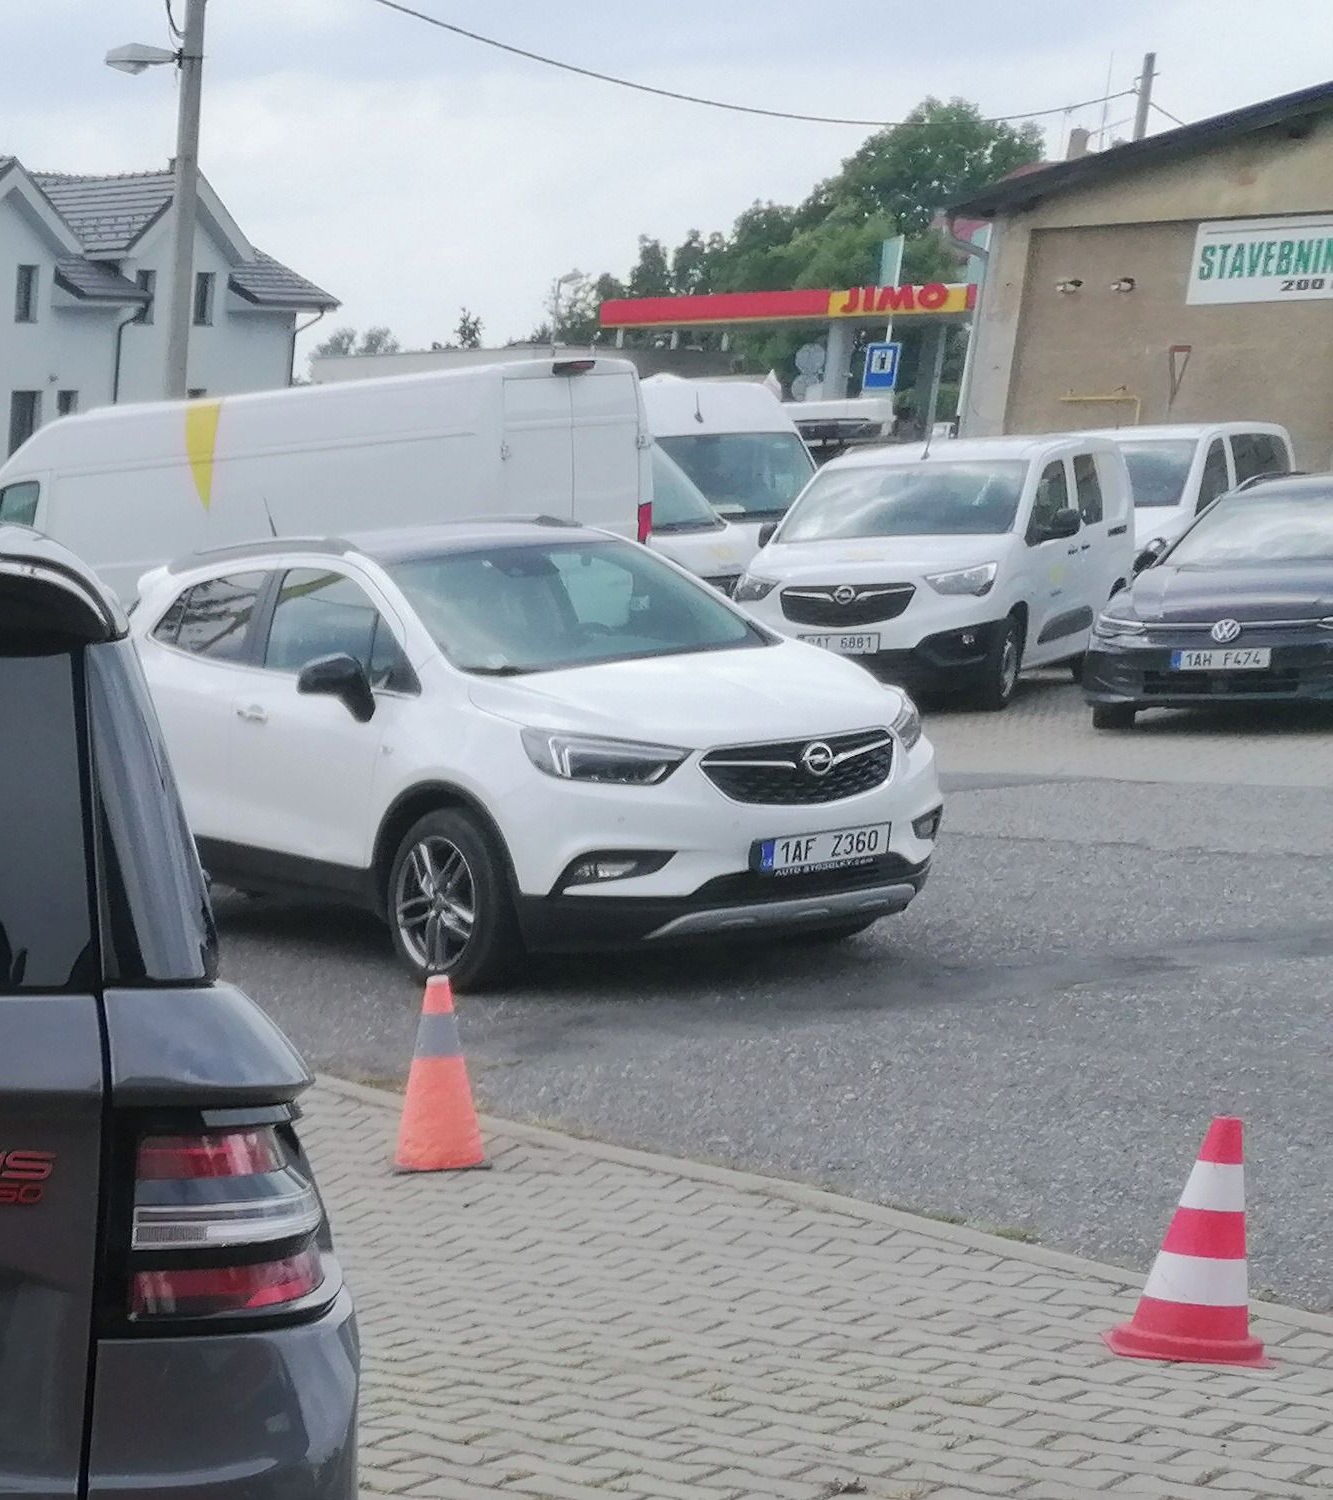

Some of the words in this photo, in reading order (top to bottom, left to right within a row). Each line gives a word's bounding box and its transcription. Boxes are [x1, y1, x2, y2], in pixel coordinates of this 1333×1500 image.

[840, 283, 949, 313] JIMO
[781, 837, 817, 864] 1AF
[830, 829, 879, 858] Z360
